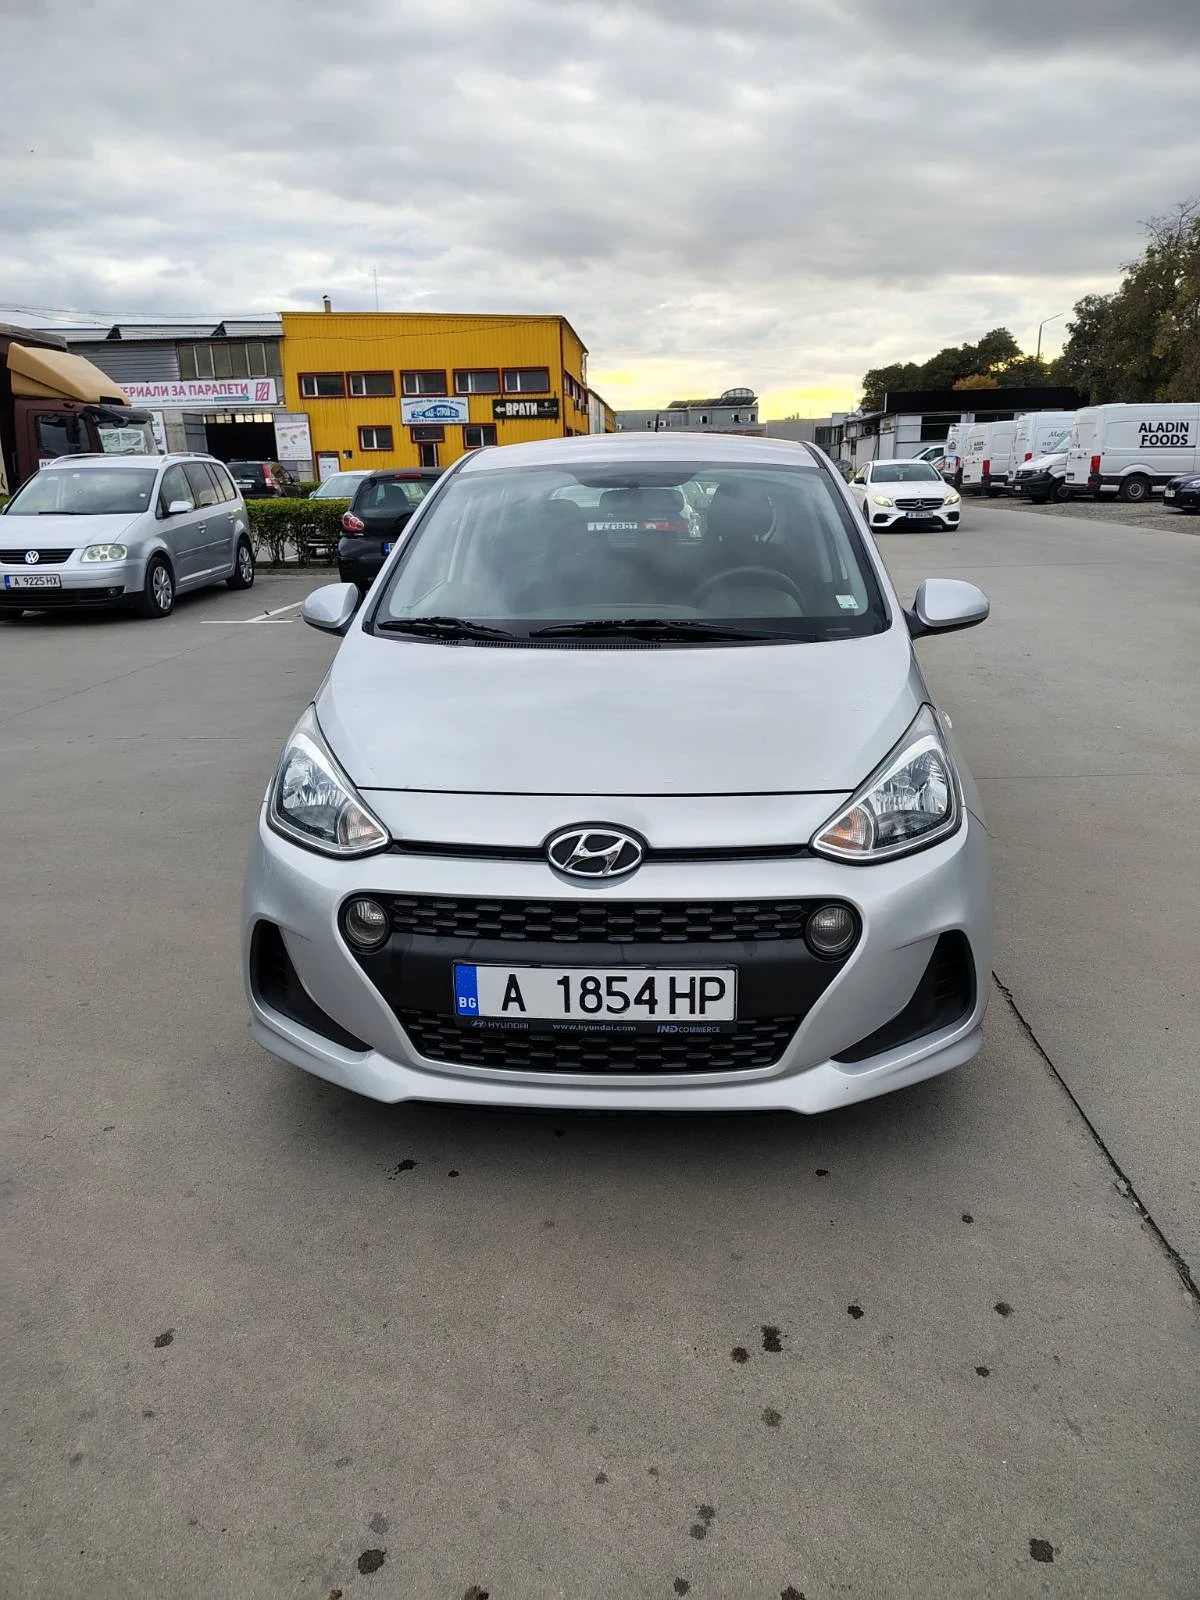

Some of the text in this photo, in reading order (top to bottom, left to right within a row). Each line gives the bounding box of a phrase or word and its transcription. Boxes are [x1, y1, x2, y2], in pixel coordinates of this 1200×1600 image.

[172, 385, 185, 396] ЗА
[189, 383, 248, 395] ПАРАПЕТИ
[505, 402, 538, 416] ВРАТИ
[1138, 422, 1189, 433] ALADIN
[1141, 434, 1188, 445] FOODS
[14, 577, 20, 586] A
[23, 576, 45, 586] 9225
[501, 973, 726, 1014] A 1854 HP
[459, 997, 477, 1008] BG
[553, 1023, 636, 1031] www.hyundai.com
